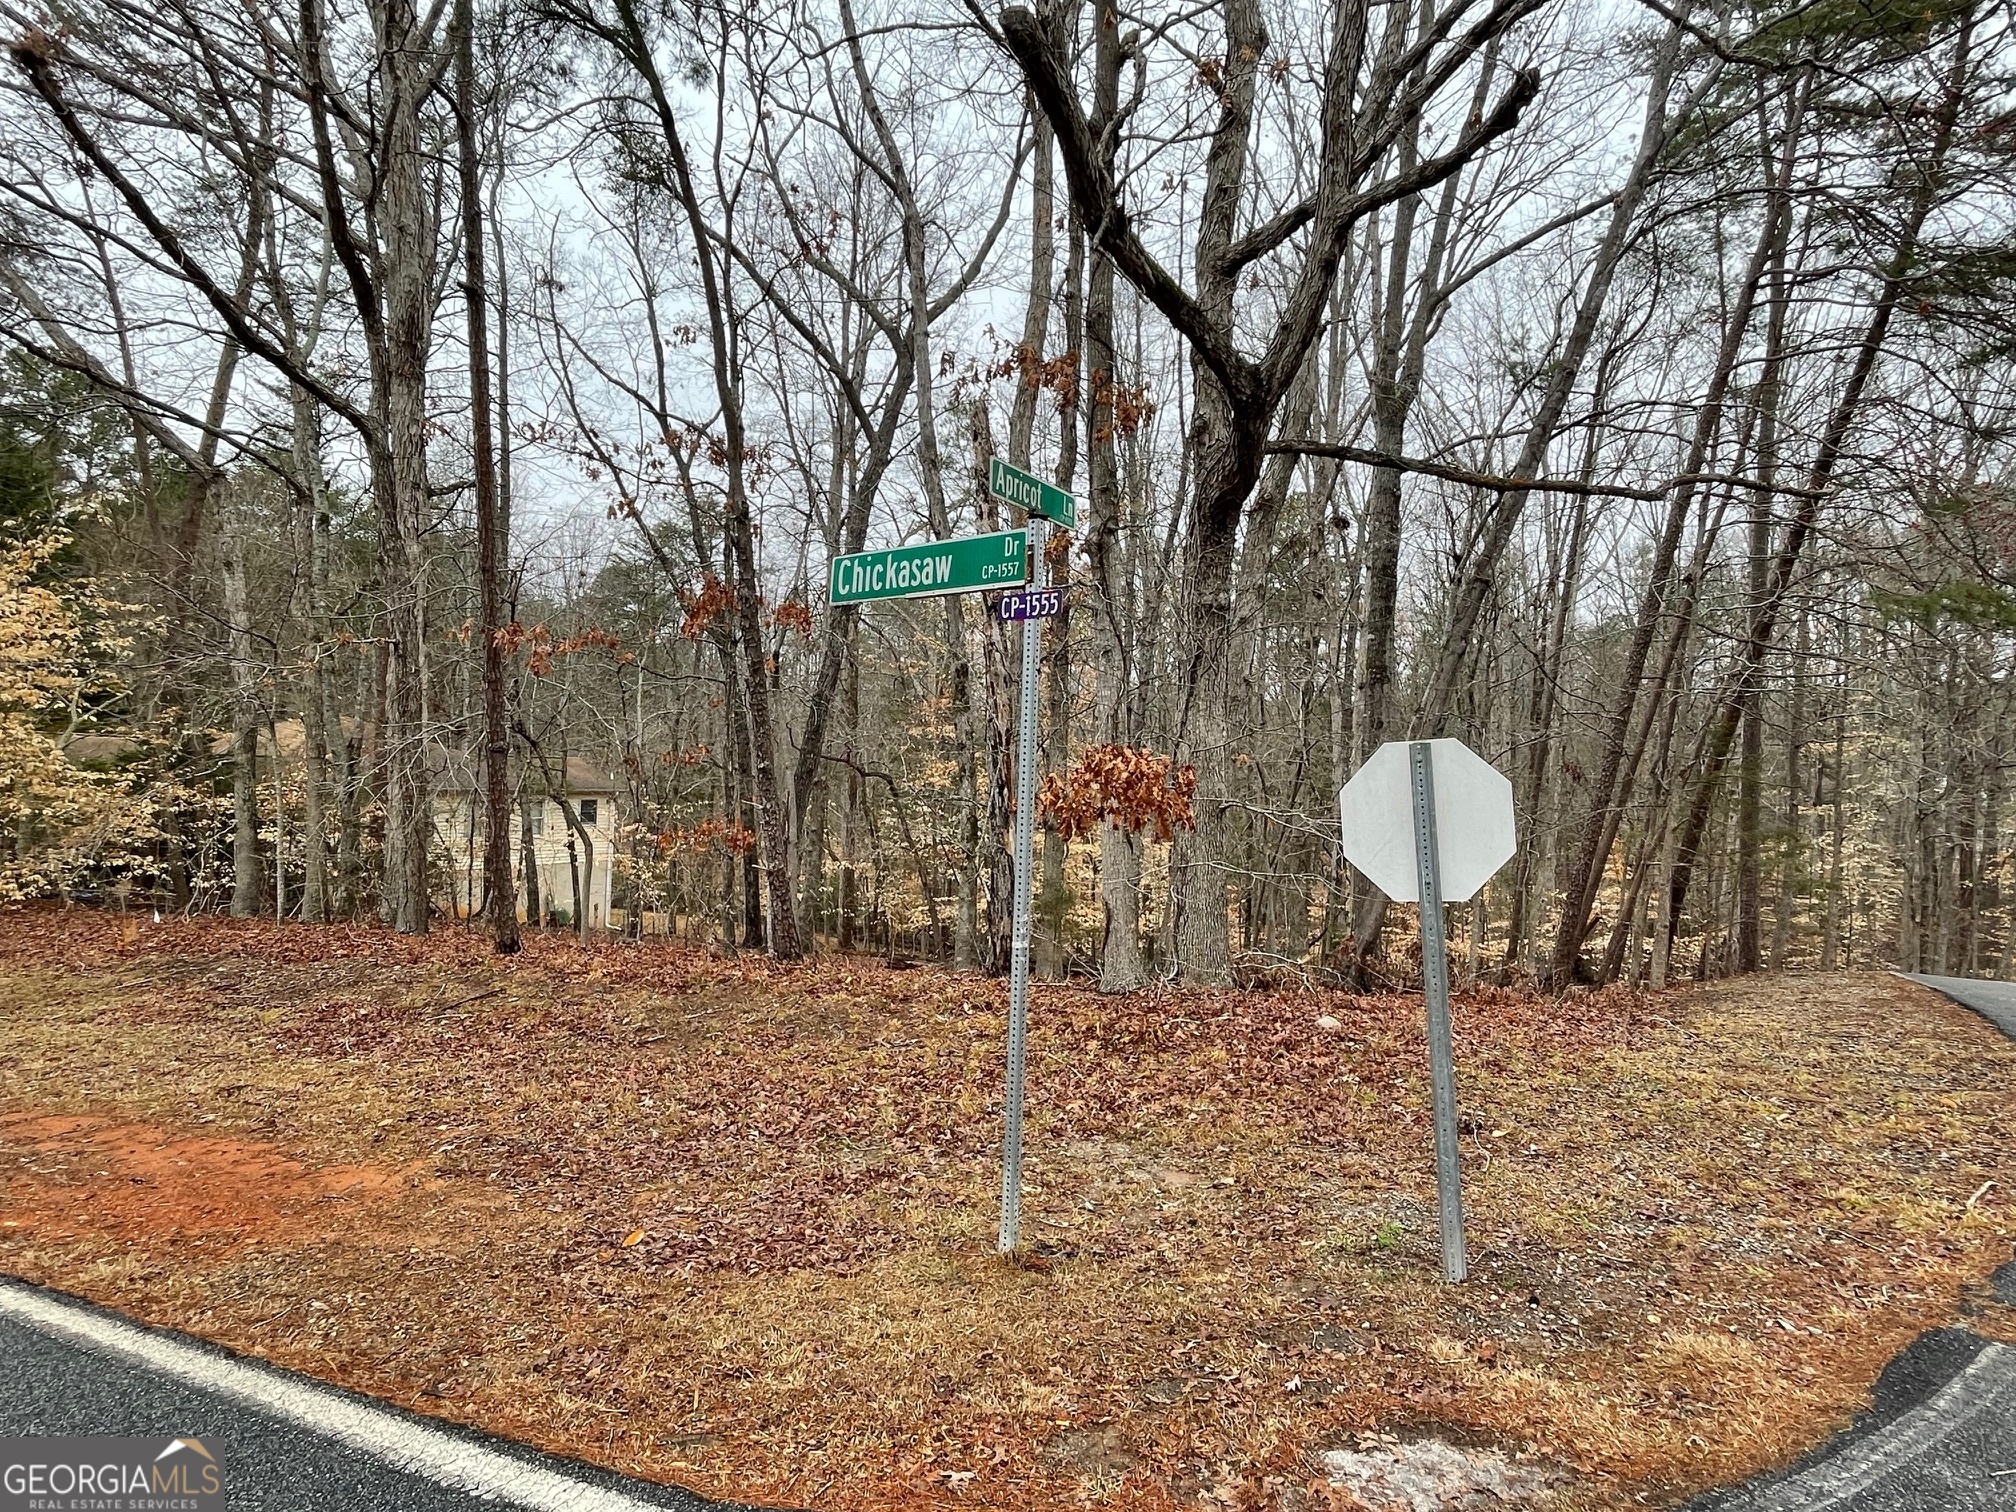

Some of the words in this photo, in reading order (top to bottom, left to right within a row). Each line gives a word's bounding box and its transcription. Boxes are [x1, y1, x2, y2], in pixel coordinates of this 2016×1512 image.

[995, 464, 1043, 510] Apricot
[1063, 495, 1073, 518] Ln
[837, 554, 953, 596] Chickasaw
[1004, 536, 1020, 557] Dr
[981, 561, 1020, 580] CP-1557
[1001, 592, 1059, 619] CP-1555
